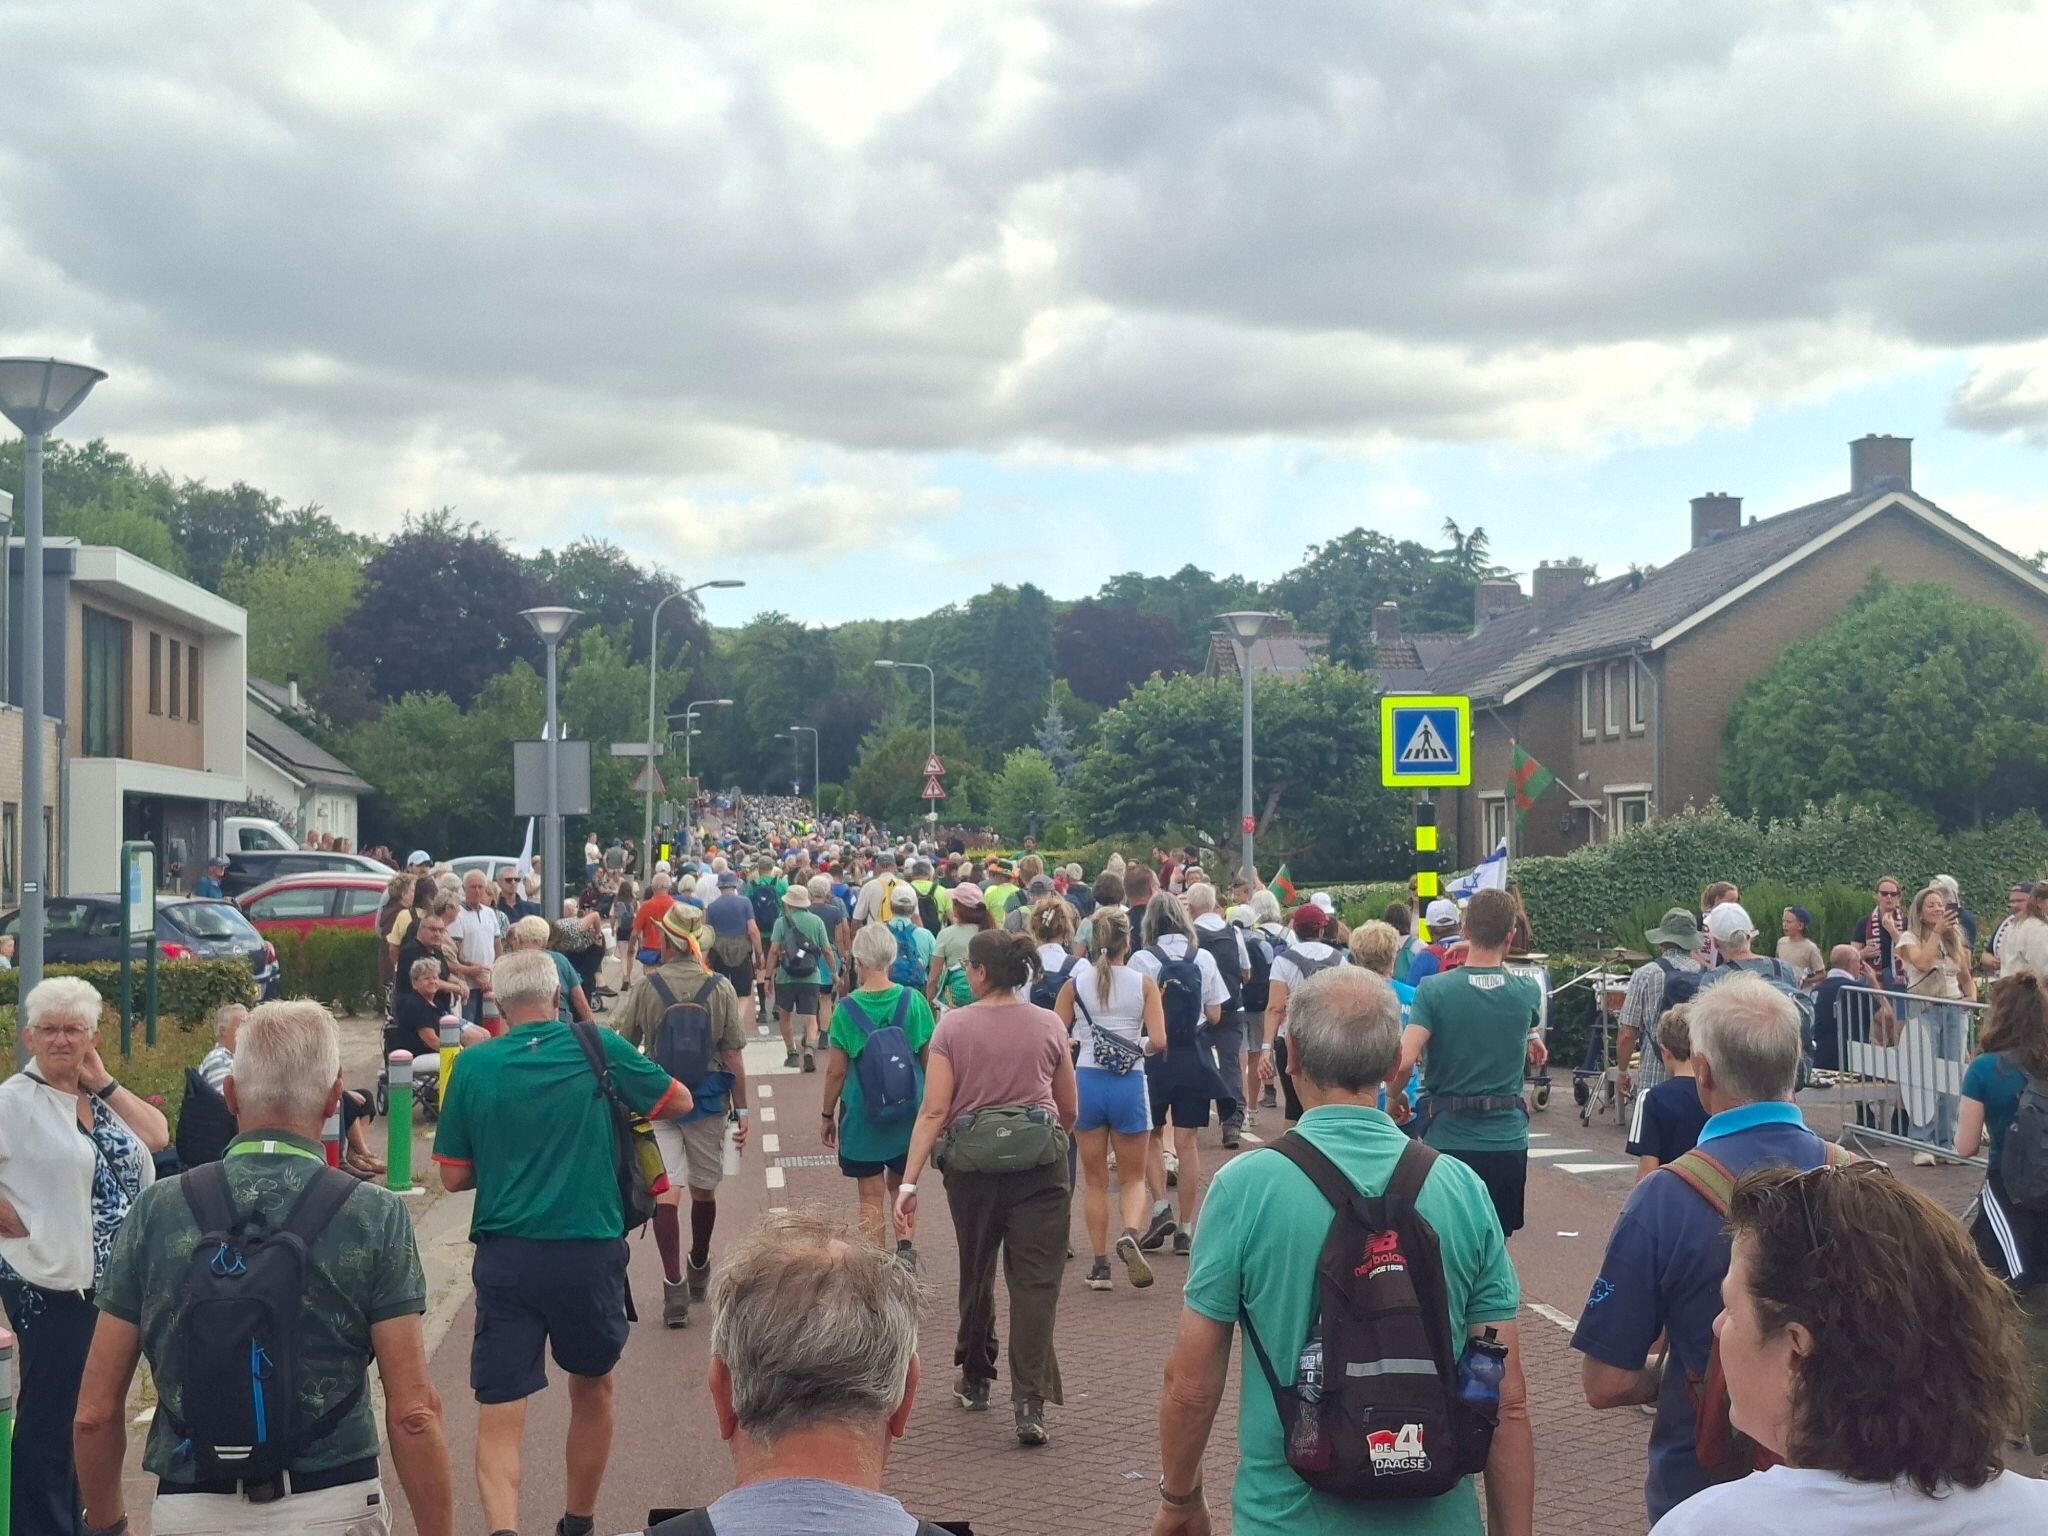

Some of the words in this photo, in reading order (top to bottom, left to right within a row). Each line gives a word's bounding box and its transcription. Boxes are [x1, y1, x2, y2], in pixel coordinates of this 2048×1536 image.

[1375, 1443, 1391, 1453] DE
[1395, 1424, 1422, 1457] 4
[1376, 1458, 1425, 1469] DAAGSE
